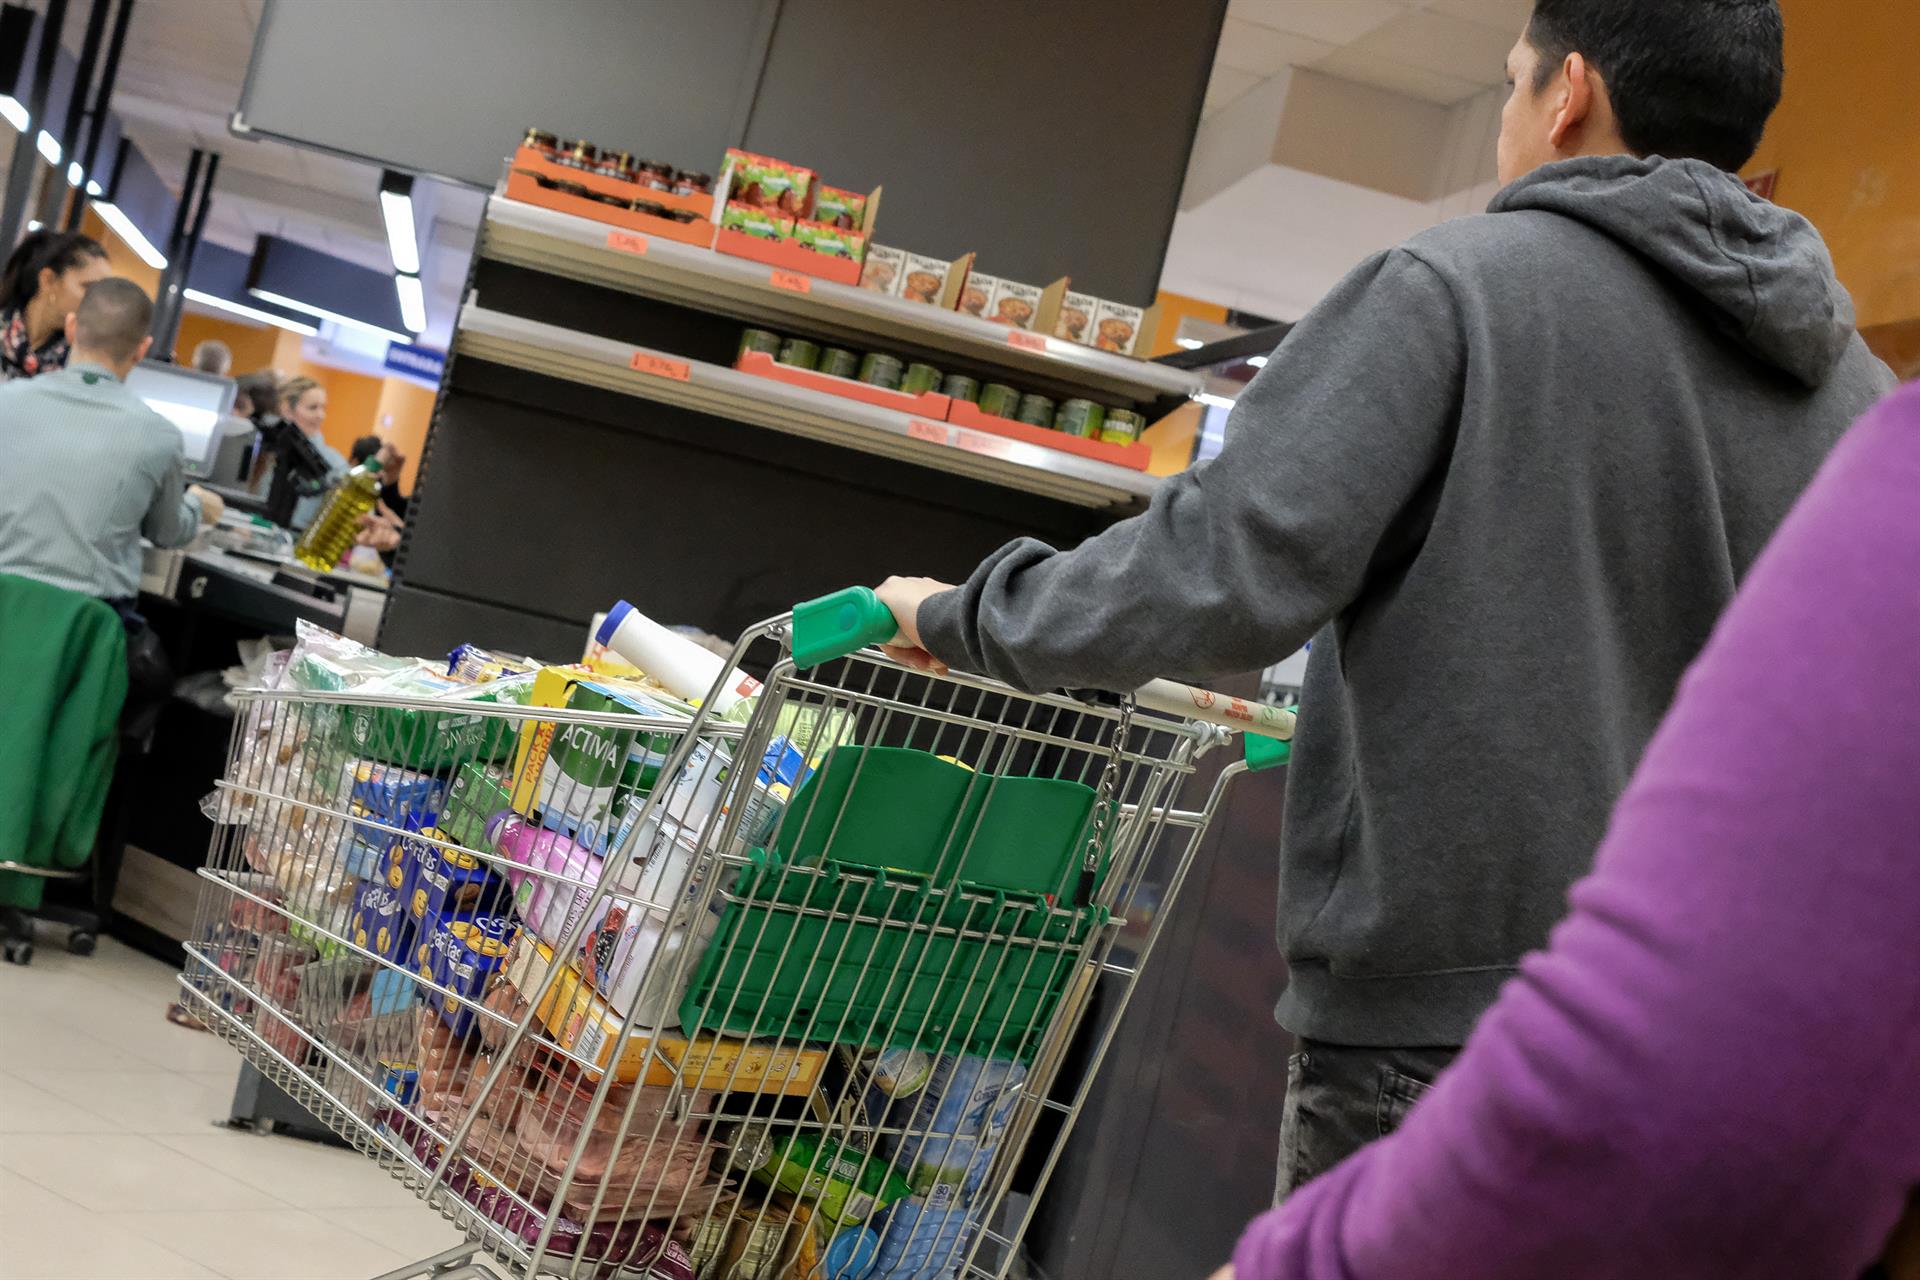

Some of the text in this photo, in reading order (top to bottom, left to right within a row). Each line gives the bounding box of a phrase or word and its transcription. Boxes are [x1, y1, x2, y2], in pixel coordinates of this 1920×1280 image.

[525, 743, 541, 784] PACK
[560, 724, 617, 769] ACTIVIA
[560, 908, 579, 945] FRUTAS
